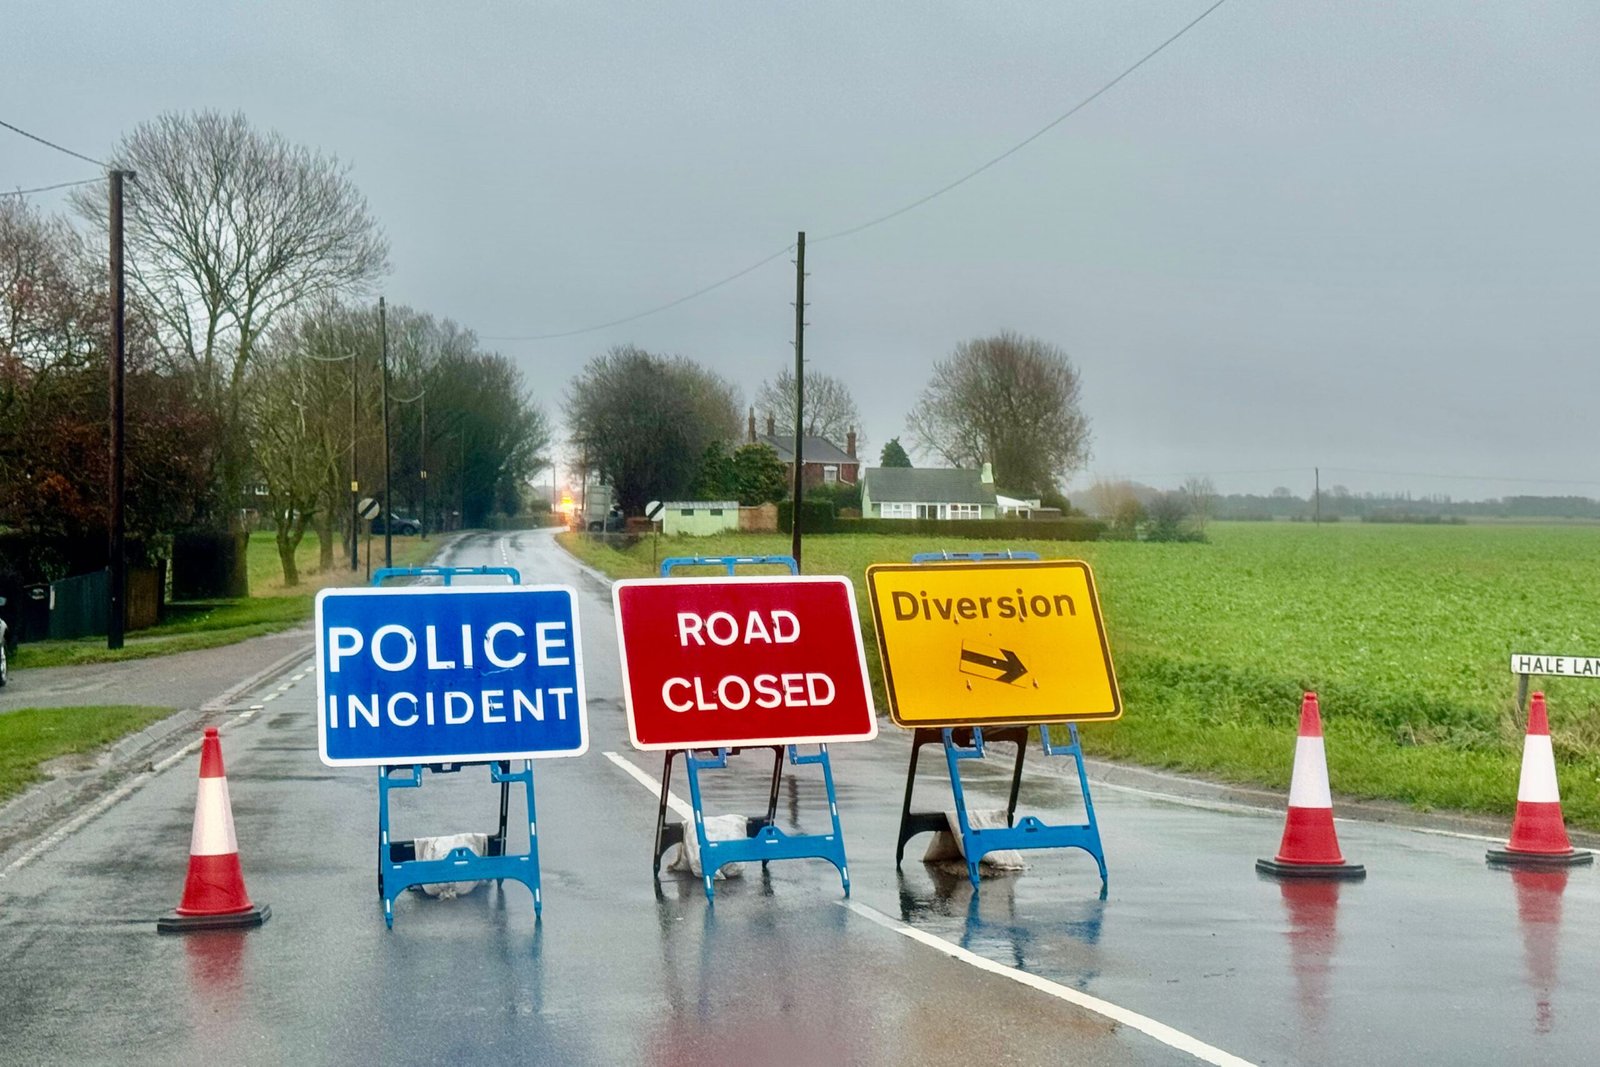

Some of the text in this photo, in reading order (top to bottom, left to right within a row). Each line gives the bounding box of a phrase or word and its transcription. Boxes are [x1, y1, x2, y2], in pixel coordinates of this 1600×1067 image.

[891, 588, 1077, 621] Diversion
[329, 621, 570, 673] POLICE
[677, 610, 801, 647] ROAD
[1519, 656, 1564, 673] HALE
[329, 687, 574, 729] INCIDENT
[661, 672, 836, 713] CLOSED
